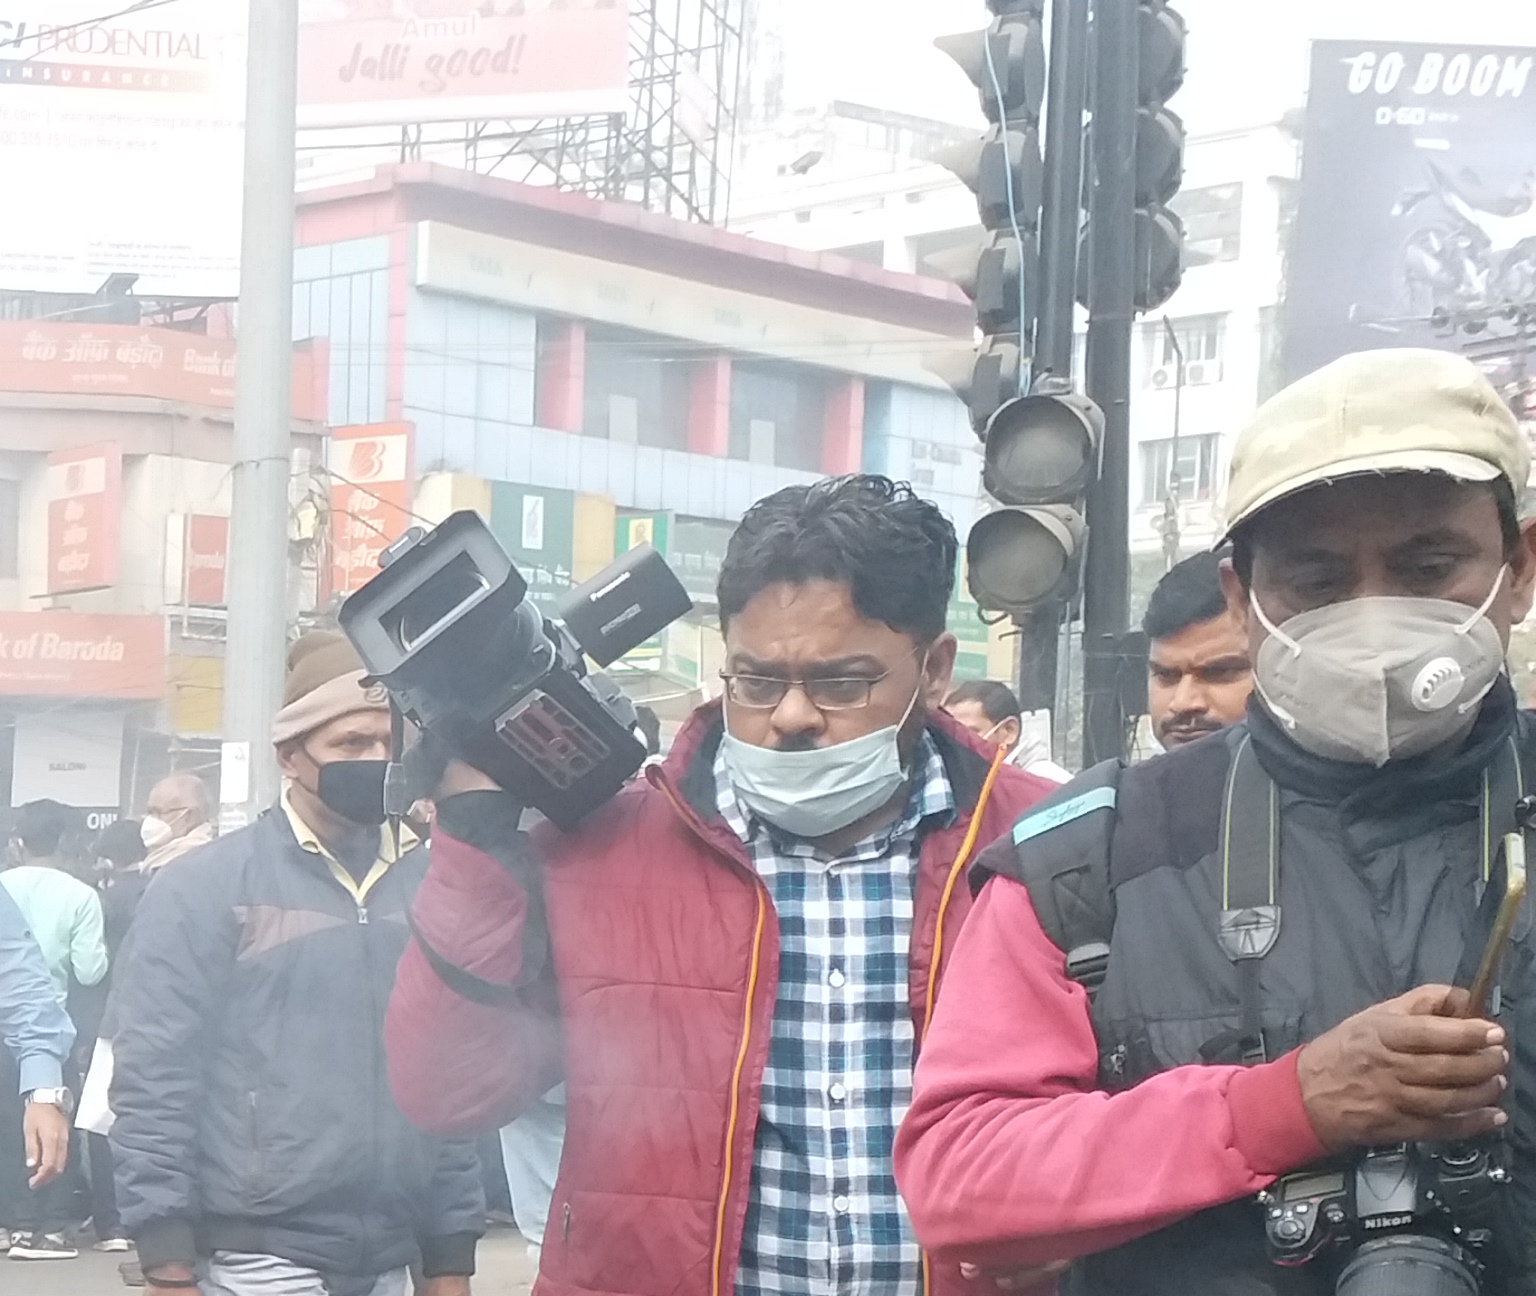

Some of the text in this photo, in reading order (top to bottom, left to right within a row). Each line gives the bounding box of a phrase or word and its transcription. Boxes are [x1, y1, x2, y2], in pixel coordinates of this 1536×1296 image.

[36, 24, 208, 60] PRUDENTIAL
[401, 17, 479, 40] Amul
[5, 67, 170, 87] INSURANCE
[338, 34, 528, 94] Jalli good!
[1339, 51, 1534, 98] GO BOOM
[12, 630, 41, 660] of
[40, 632, 126, 662] Baroda
[1364, 1214, 1412, 1230] Nikon
